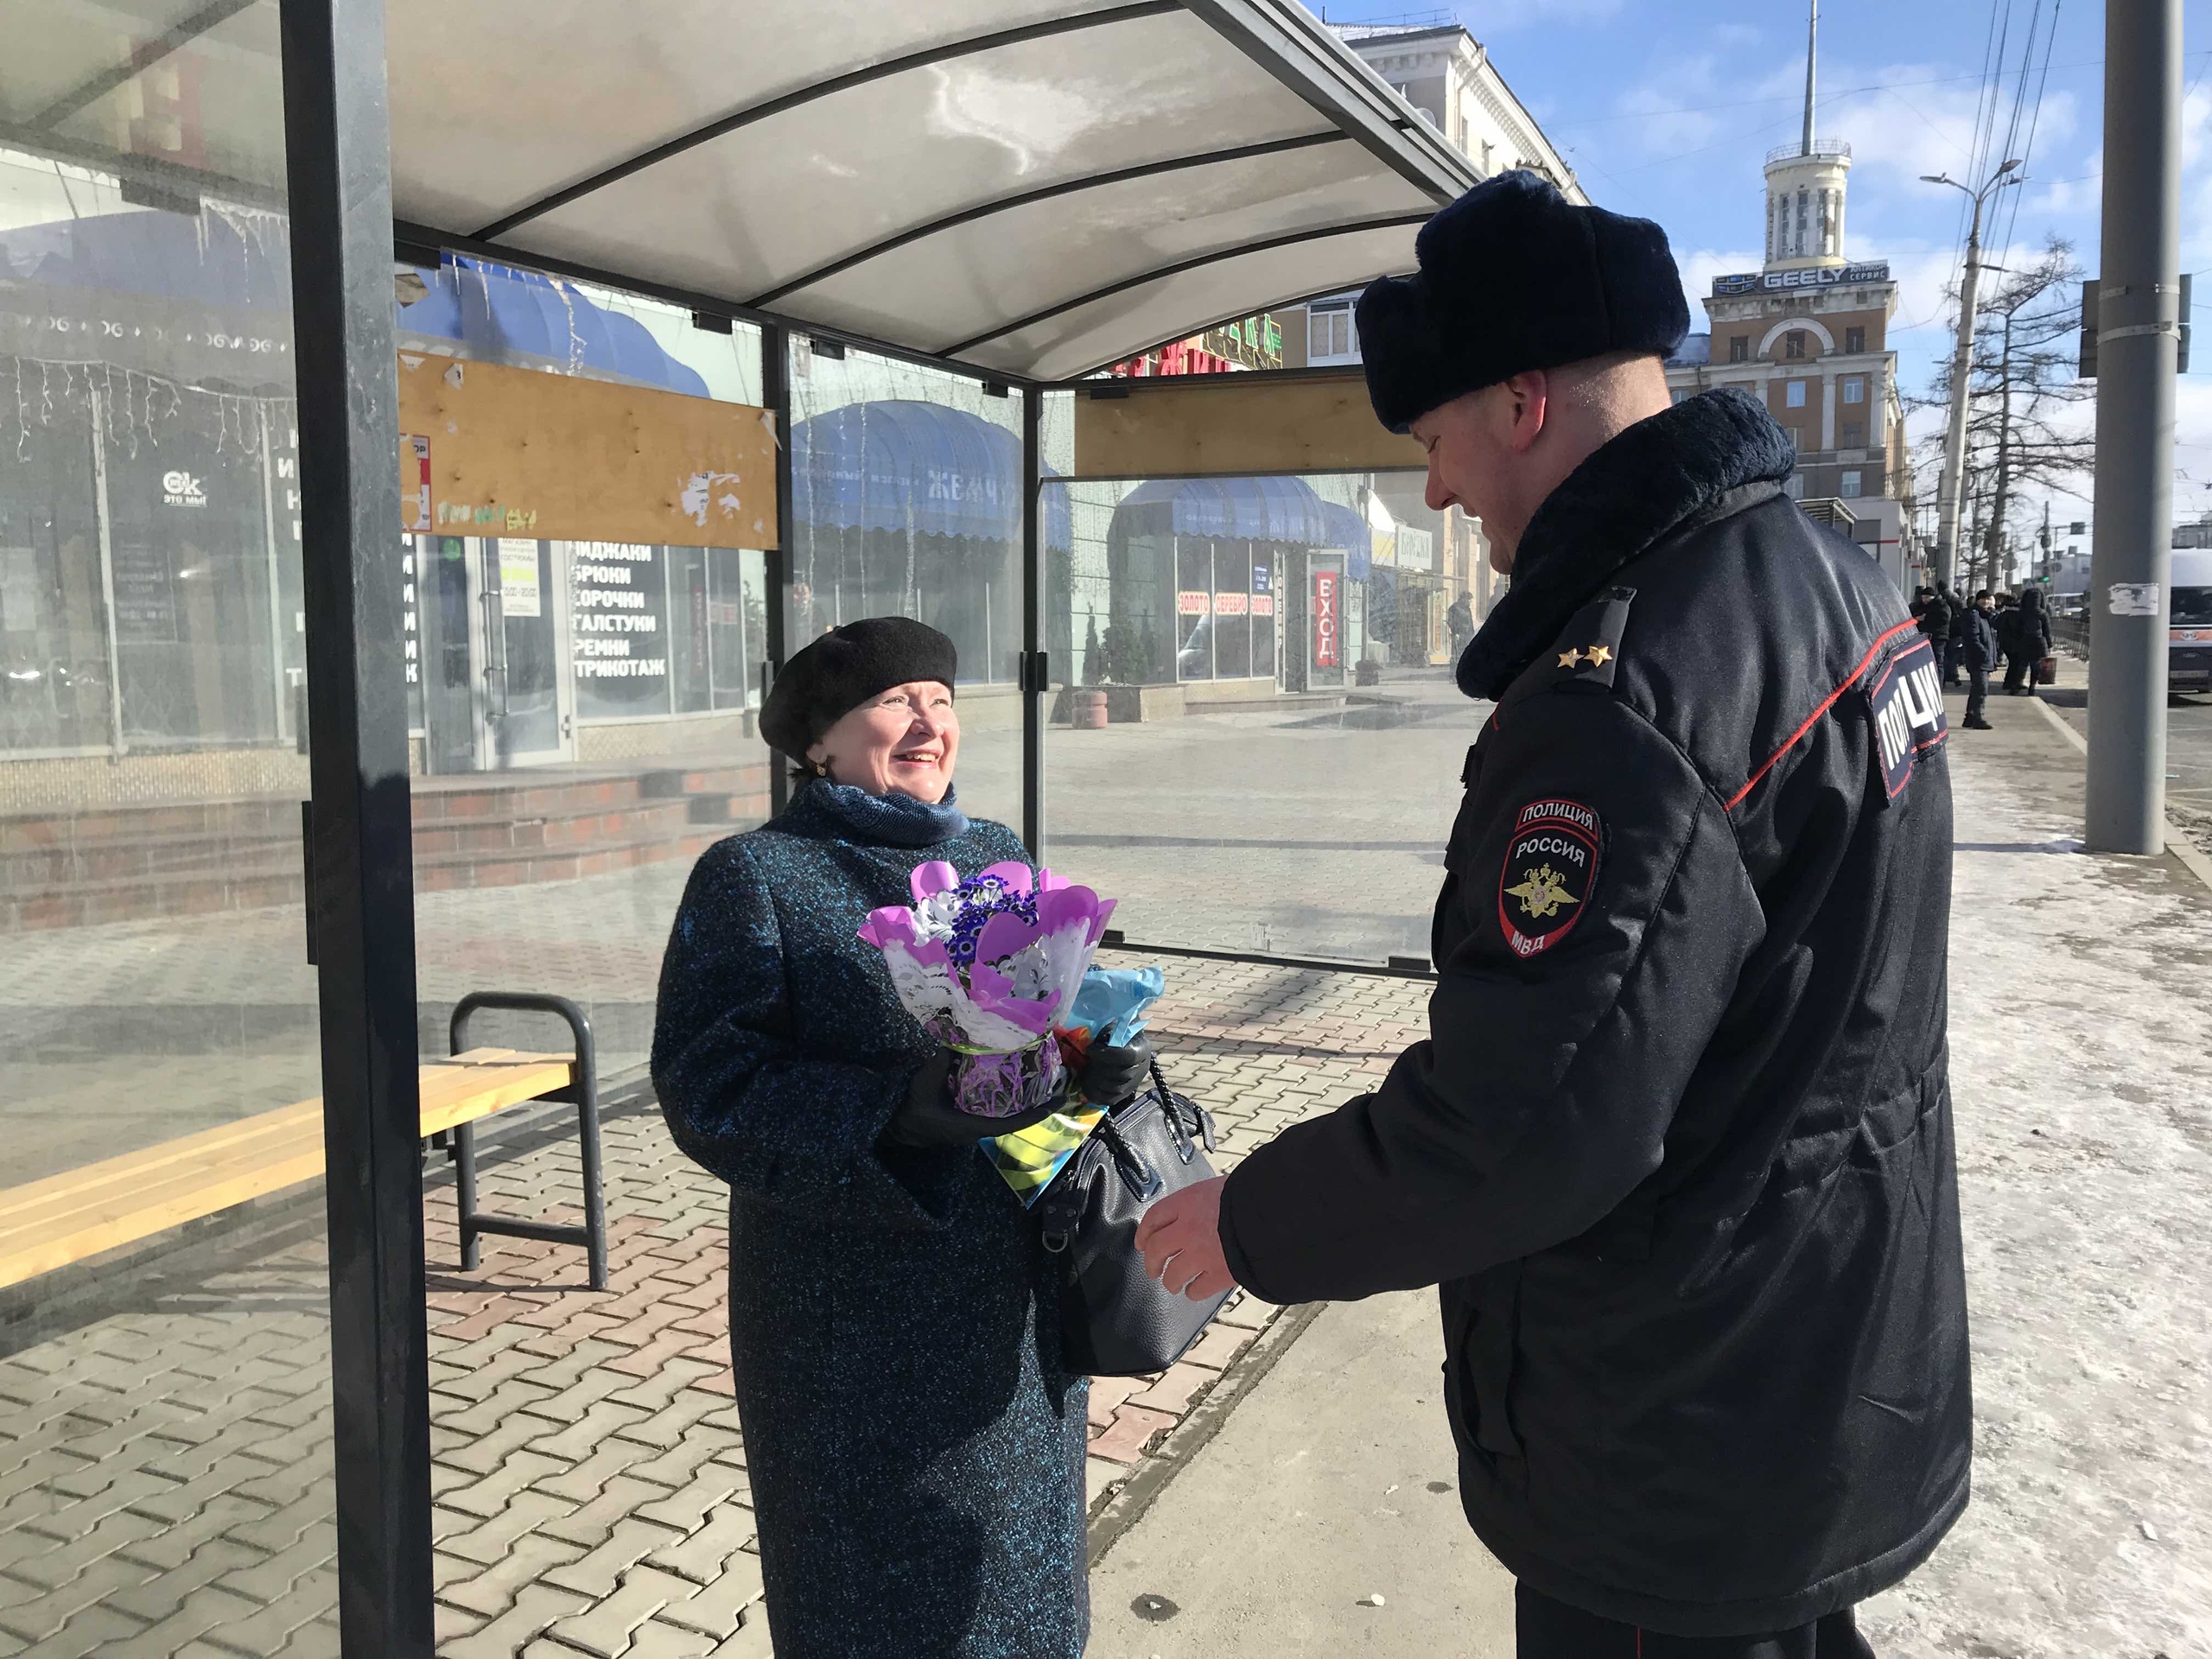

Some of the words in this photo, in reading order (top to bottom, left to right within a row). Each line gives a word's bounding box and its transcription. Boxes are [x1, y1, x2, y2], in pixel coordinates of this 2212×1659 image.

[1764, 267, 1847, 289] GEELY
[1850, 270, 1885, 281] СЕРВИС
[1179, 594, 1210, 613] ЗОЛОТО
[1215, 594, 1248, 613] СЕРЕБРО
[1319, 579, 1335, 659] ВХОД
[574, 658, 666, 678] ТРИКОТАЖ
[1522, 803, 1593, 830] ПОЛИЦИЯ
[1516, 837, 1585, 868] РОССИЯ
[1512, 930, 1545, 955] МВД
